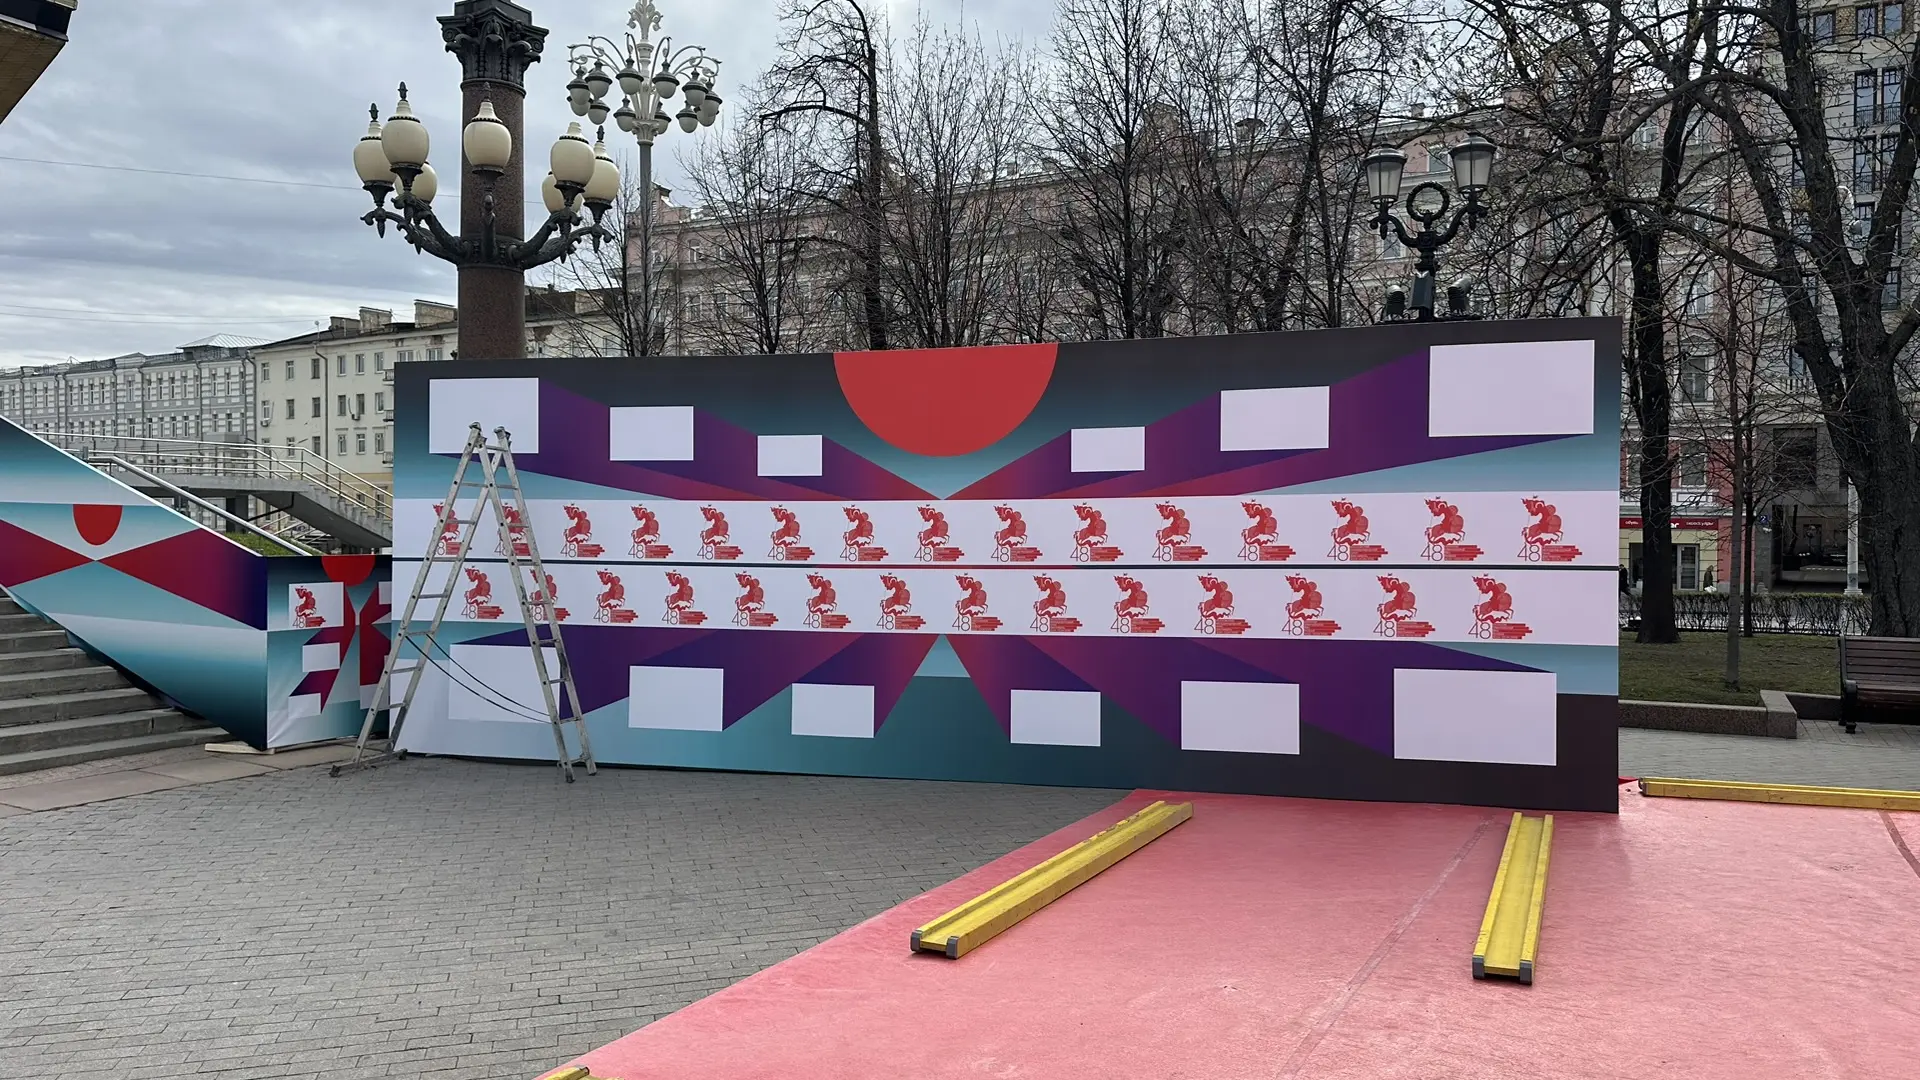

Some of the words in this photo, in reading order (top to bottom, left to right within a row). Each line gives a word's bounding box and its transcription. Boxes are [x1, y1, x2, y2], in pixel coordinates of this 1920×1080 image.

[560, 542, 576, 558] 48
[628, 543, 644, 559] 48
[697, 544, 713, 560] 48
[768, 544, 784, 561] 48
[840, 545, 857, 562] 48
[914, 545, 932, 562] 48
[991, 545, 1010, 562] 48
[1070, 545, 1089, 562] 48
[1152, 545, 1172, 562] 48
[1238, 544, 1258, 562] 48
[1327, 544, 1348, 561] 48
[1420, 543, 1443, 561] 48
[1517, 543, 1540, 562] 48
[461, 604, 477, 620] 48
[593, 606, 609, 623] 48
[662, 609, 678, 625] 48
[732, 610, 748, 627] 48
[803, 612, 820, 628] 48
[292, 616, 306, 628] 48
[876, 614, 894, 630] 48
[952, 614, 970, 632] 48
[1030, 615, 1048, 632] 48
[1110, 616, 1130, 634] 48
[1194, 617, 1215, 634] 48
[1282, 618, 1303, 636] 48
[1373, 620, 1395, 638] 48
[1468, 620, 1491, 640] 48
